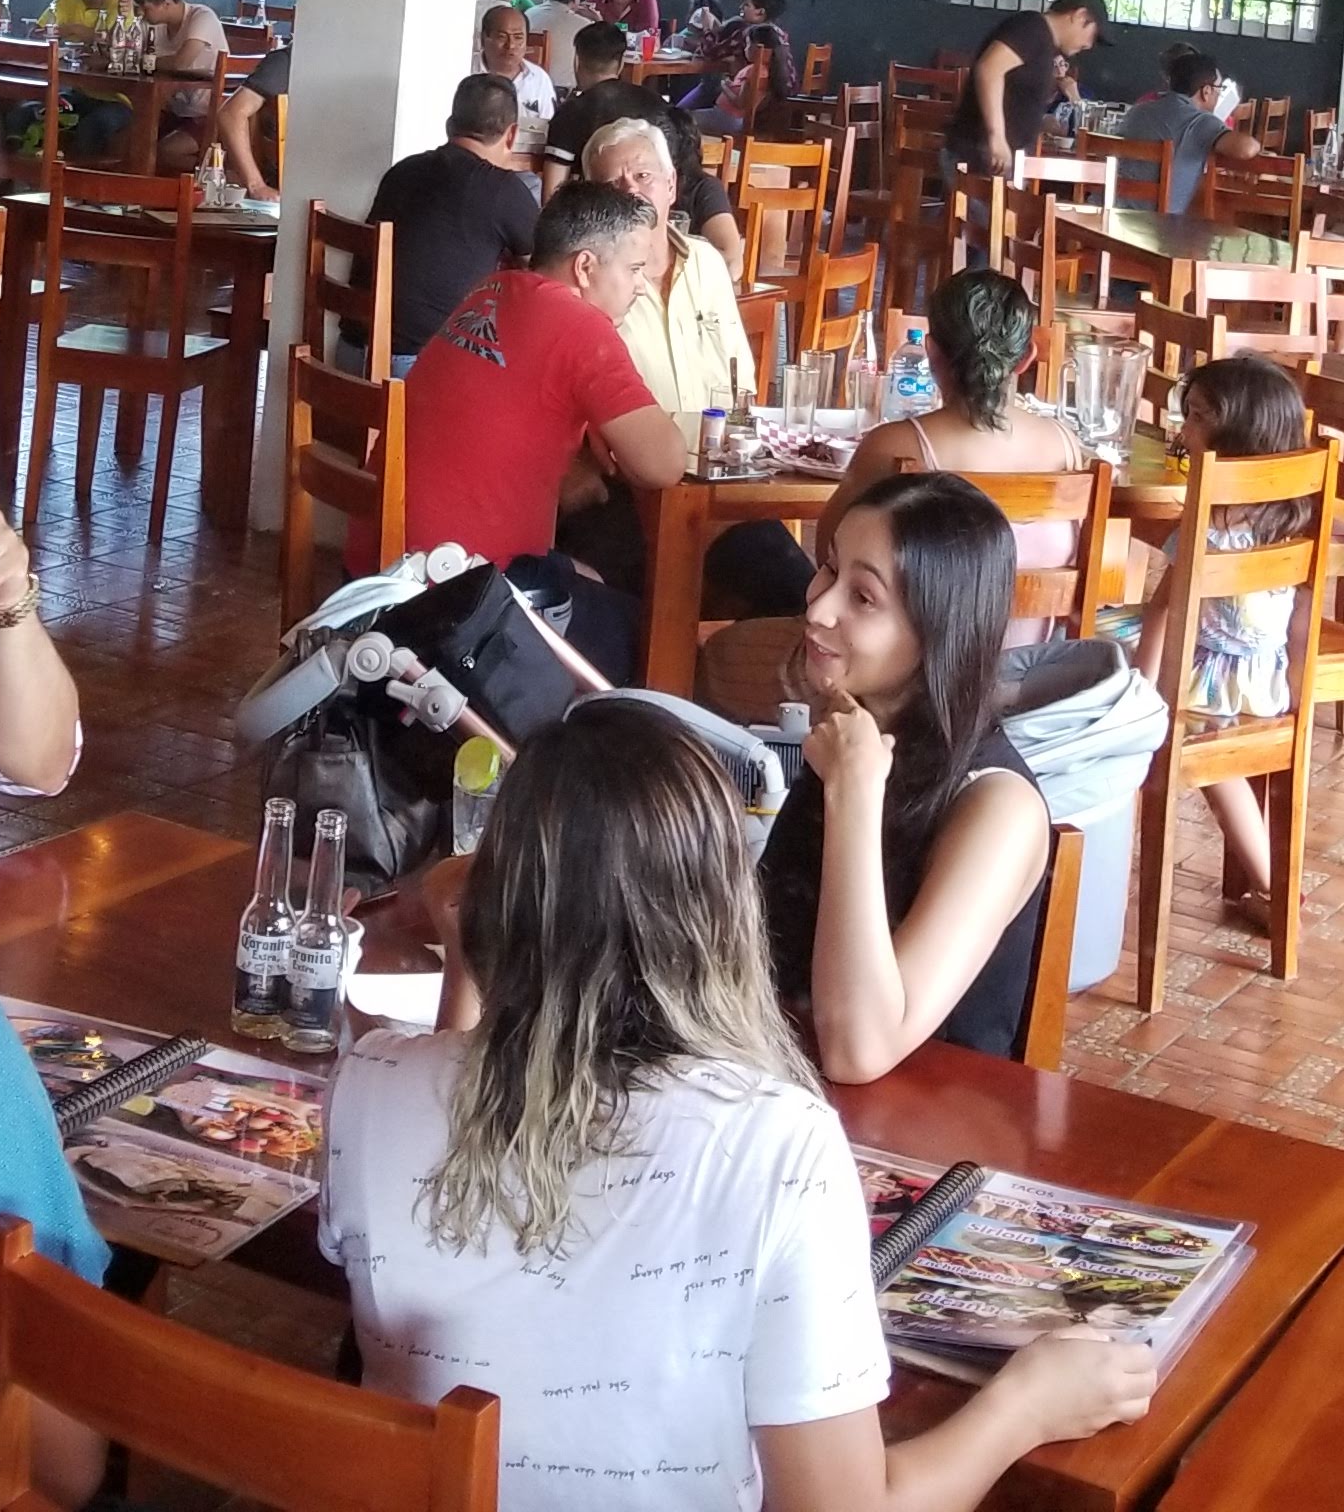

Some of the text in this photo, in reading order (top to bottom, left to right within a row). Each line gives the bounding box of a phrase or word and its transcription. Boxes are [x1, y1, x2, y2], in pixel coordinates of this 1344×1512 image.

[289, 948, 332, 964] oronita
[649, 1169, 675, 1183] days
[1011, 1183, 1054, 1198] TACOS
[1075, 1259, 1180, 1283] Arrachera
